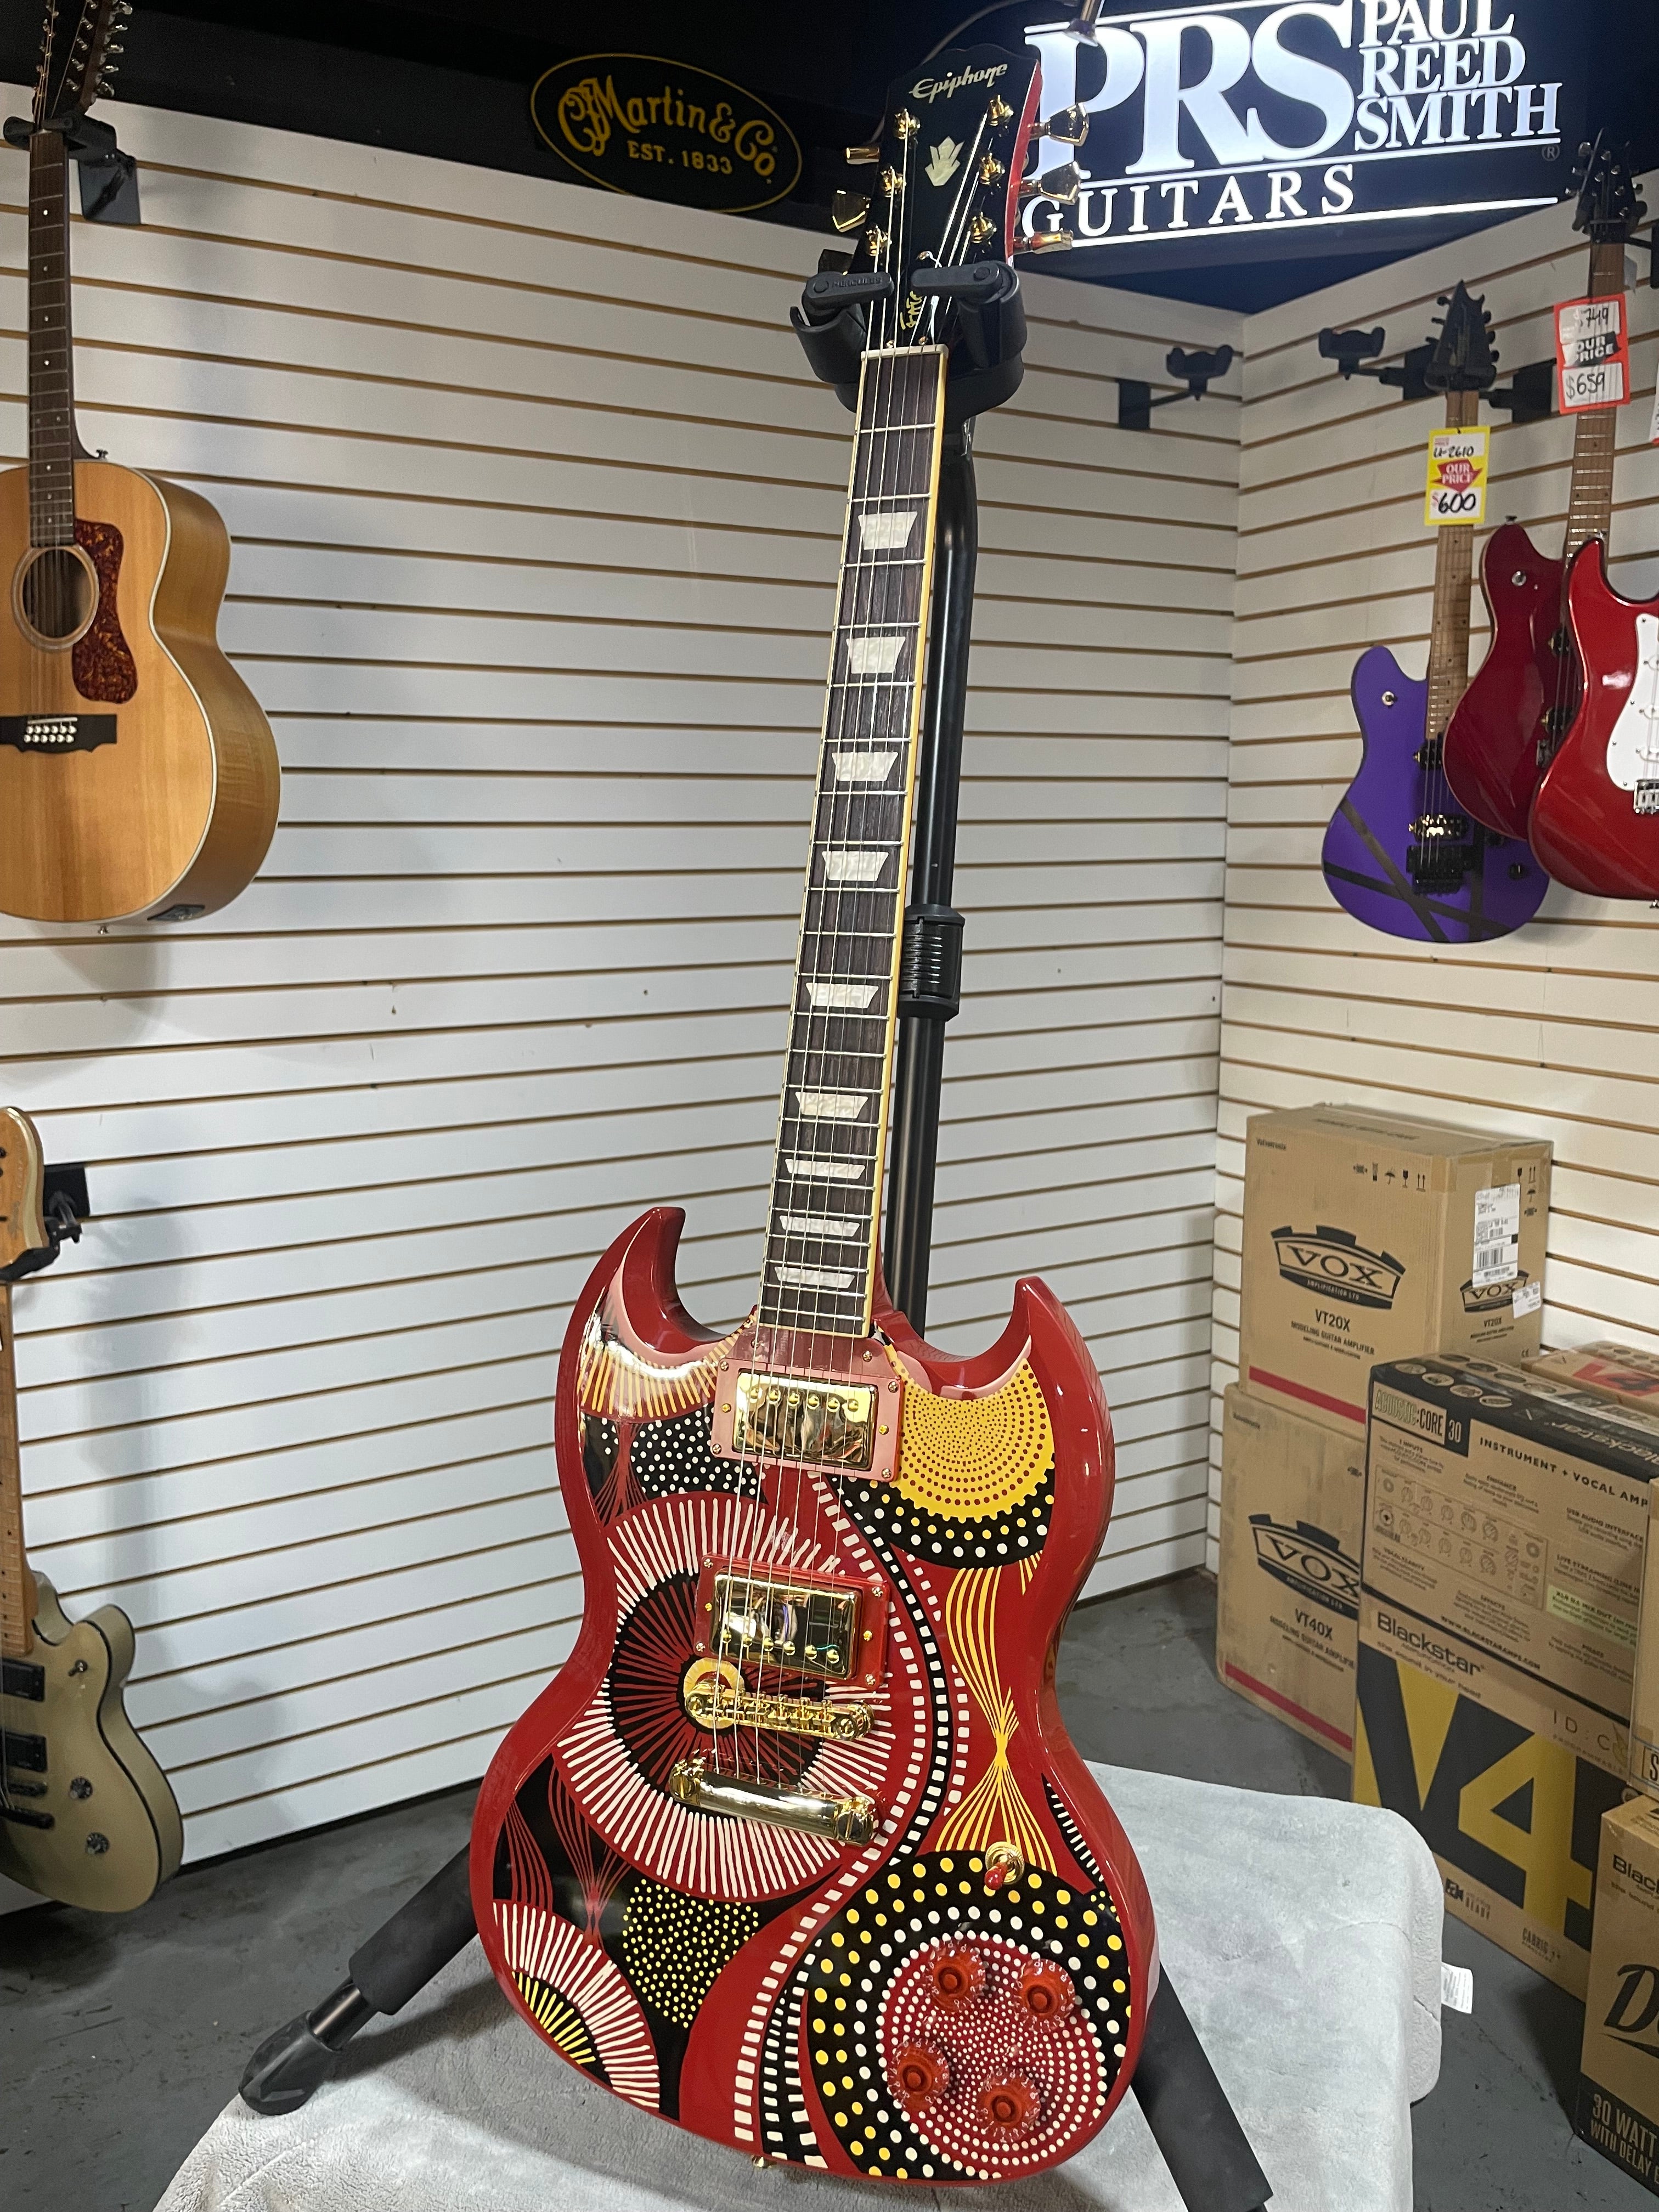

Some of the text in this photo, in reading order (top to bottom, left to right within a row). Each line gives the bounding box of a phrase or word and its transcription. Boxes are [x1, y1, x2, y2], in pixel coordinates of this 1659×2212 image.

[1359, 0, 1515, 48] PAUL
[909, 64, 1008, 104] Epiphone
[1357, 35, 1526, 99] REED
[1024, 0, 1355, 180] PRS
[1355, 83, 1563, 151] SMITH
[627, 140, 733, 174] EST. 1833
[1022, 164, 1354, 238] GUITARS
[1576, 343, 1614, 363] RICE
[1566, 371, 1605, 399] $659
[1442, 473, 1474, 485] PRICE
[1446, 462, 1470, 475] OUR
[1287, 1245, 1383, 1289] VOX
[1470, 1280, 1519, 1299] VOX
[1315, 1308, 1351, 1333] VT20X
[1321, 1330, 1342, 1344] GUITAR
[1344, 1338, 1375, 1356] AMPLIFIER
[1448, 1419, 1462, 1443] 30
[1480, 1437, 1557, 1472] INSTRUMENT
[1573, 1472, 1615, 1496] VOCAL
[1266, 1534, 1359, 1598] VOX
[1295, 1608, 1333, 1641] VT40X
[1377, 1611, 1481, 1676] Blackstar
[1604, 1963, 1659, 2033] D
[1590, 2119, 1617, 2152] WITH
[1619, 2140, 1652, 2177] DELAY
[1593, 2094, 1657, 2158] 30 WATT
